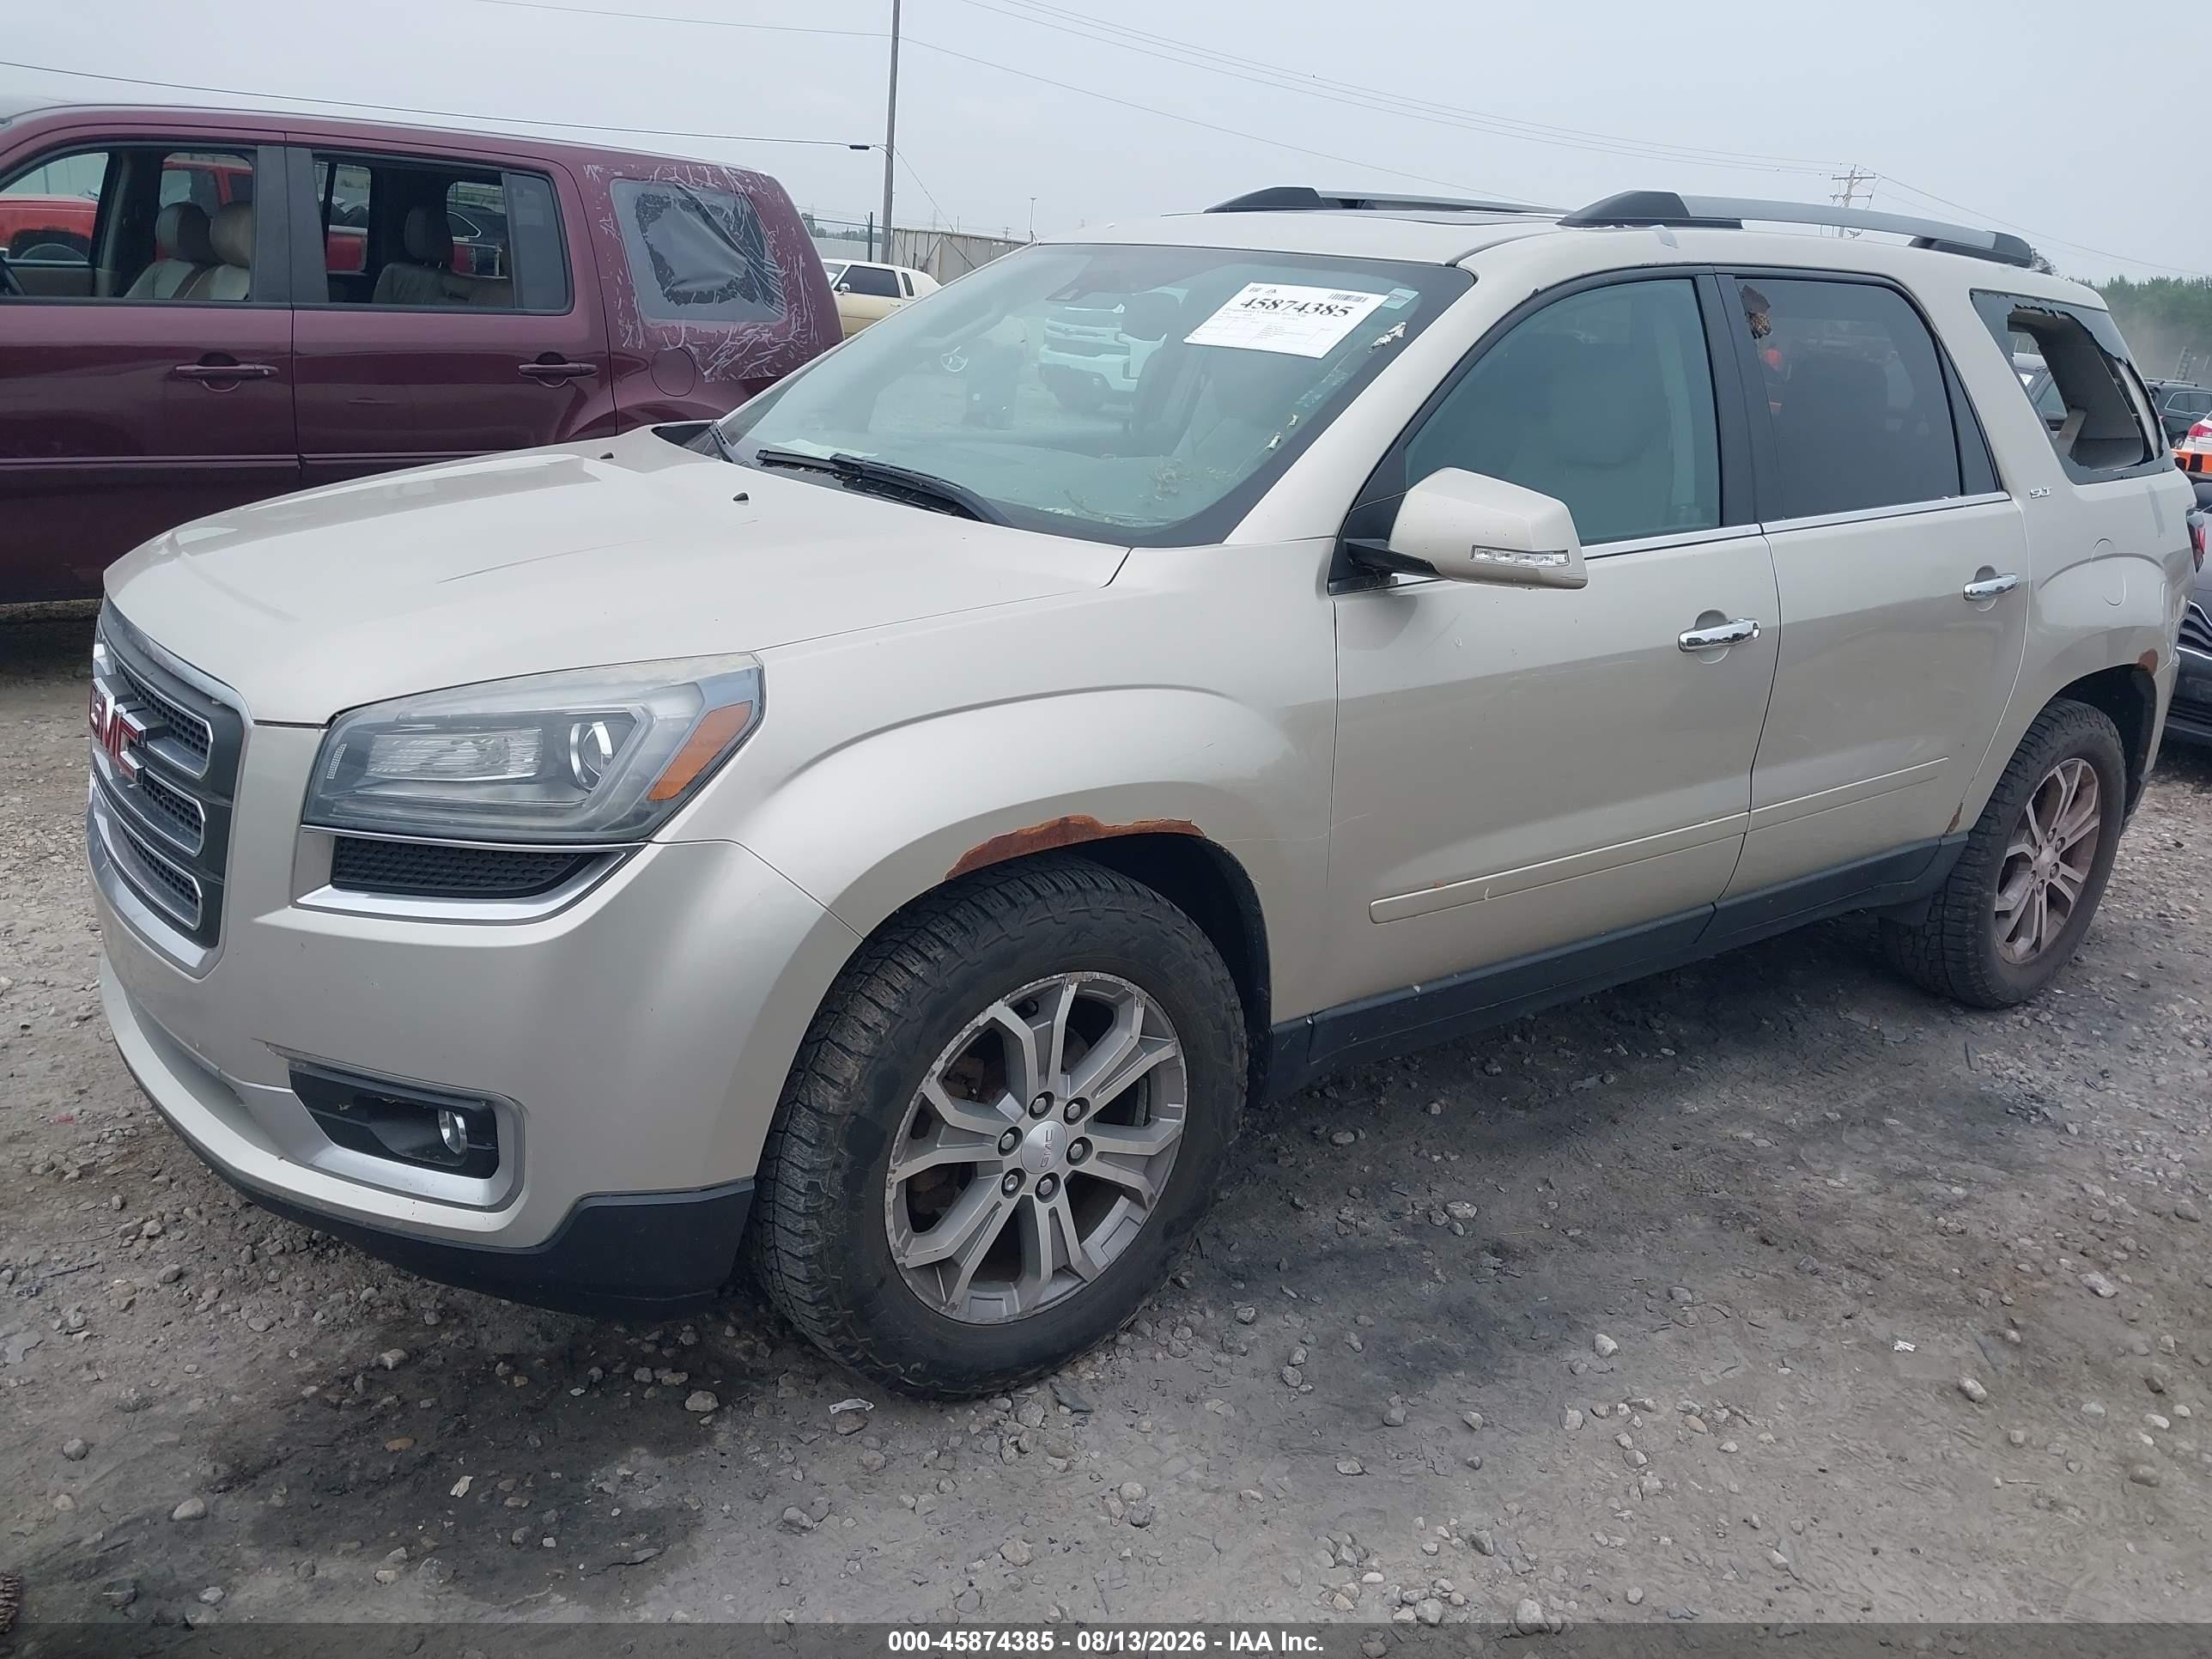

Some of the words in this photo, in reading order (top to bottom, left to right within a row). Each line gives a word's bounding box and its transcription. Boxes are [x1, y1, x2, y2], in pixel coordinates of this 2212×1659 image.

[1239, 297, 1354, 318] 45874385
[2030, 487, 2051, 499] SLT
[89, 678, 146, 783] GMC
[1040, 1128, 1054, 1168] GMC
